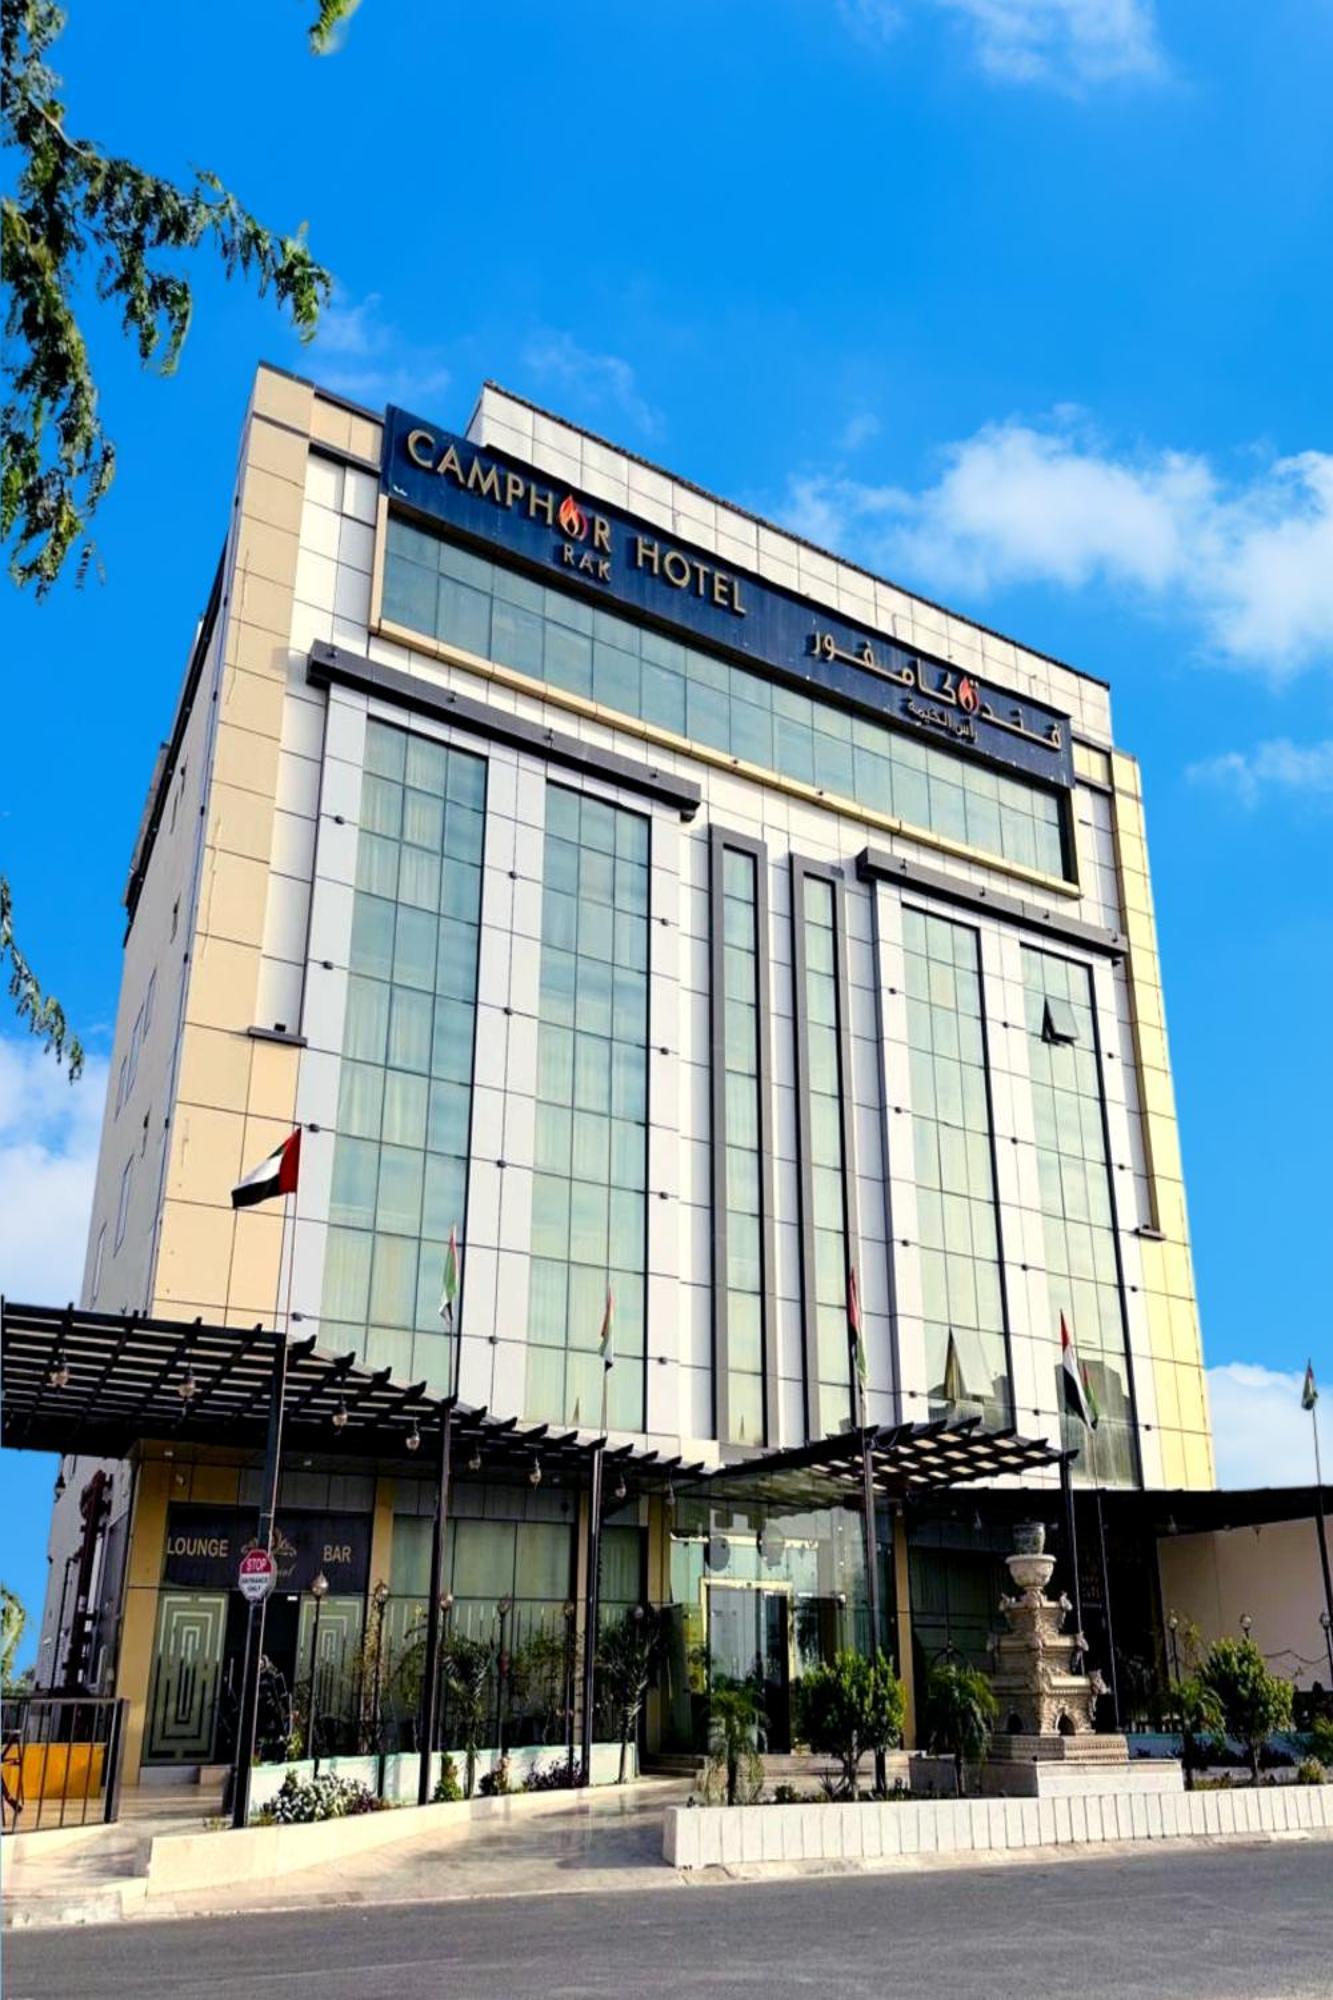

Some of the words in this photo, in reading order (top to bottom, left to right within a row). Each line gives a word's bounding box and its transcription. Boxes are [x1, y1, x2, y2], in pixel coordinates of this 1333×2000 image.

[407, 430, 612, 552] CAMPHOR
[635, 537, 747, 616] HOTEL
[563, 543, 612, 582] RAK
[167, 1537, 229, 1558] LOUNGE
[323, 1545, 352, 1562] BAR
[246, 1558, 267, 1572] STOP
